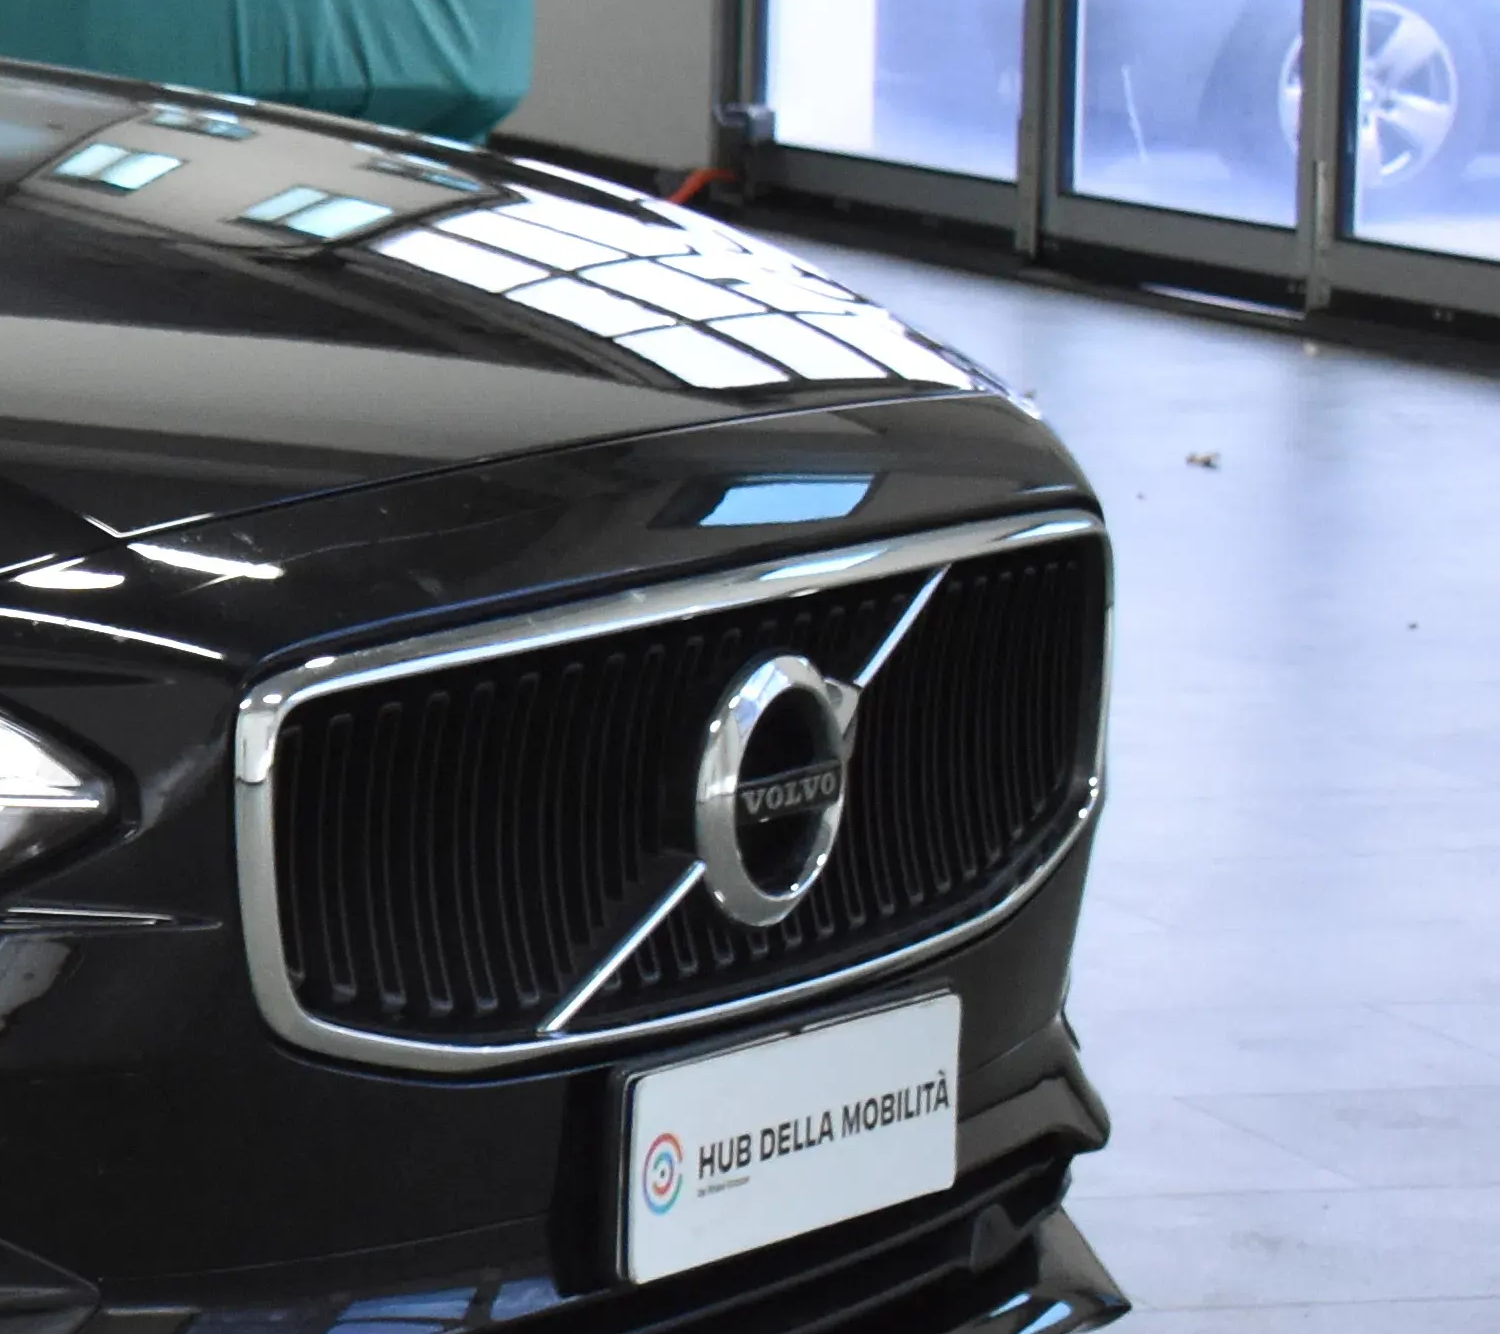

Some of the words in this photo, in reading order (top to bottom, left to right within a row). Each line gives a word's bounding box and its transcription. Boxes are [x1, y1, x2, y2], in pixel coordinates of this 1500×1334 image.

[742, 771, 837, 815] VOLVO
[698, 1133, 753, 1180] HUB
[759, 1110, 834, 1162] DELLA
[841, 1069, 950, 1138] MOBILITÀ
